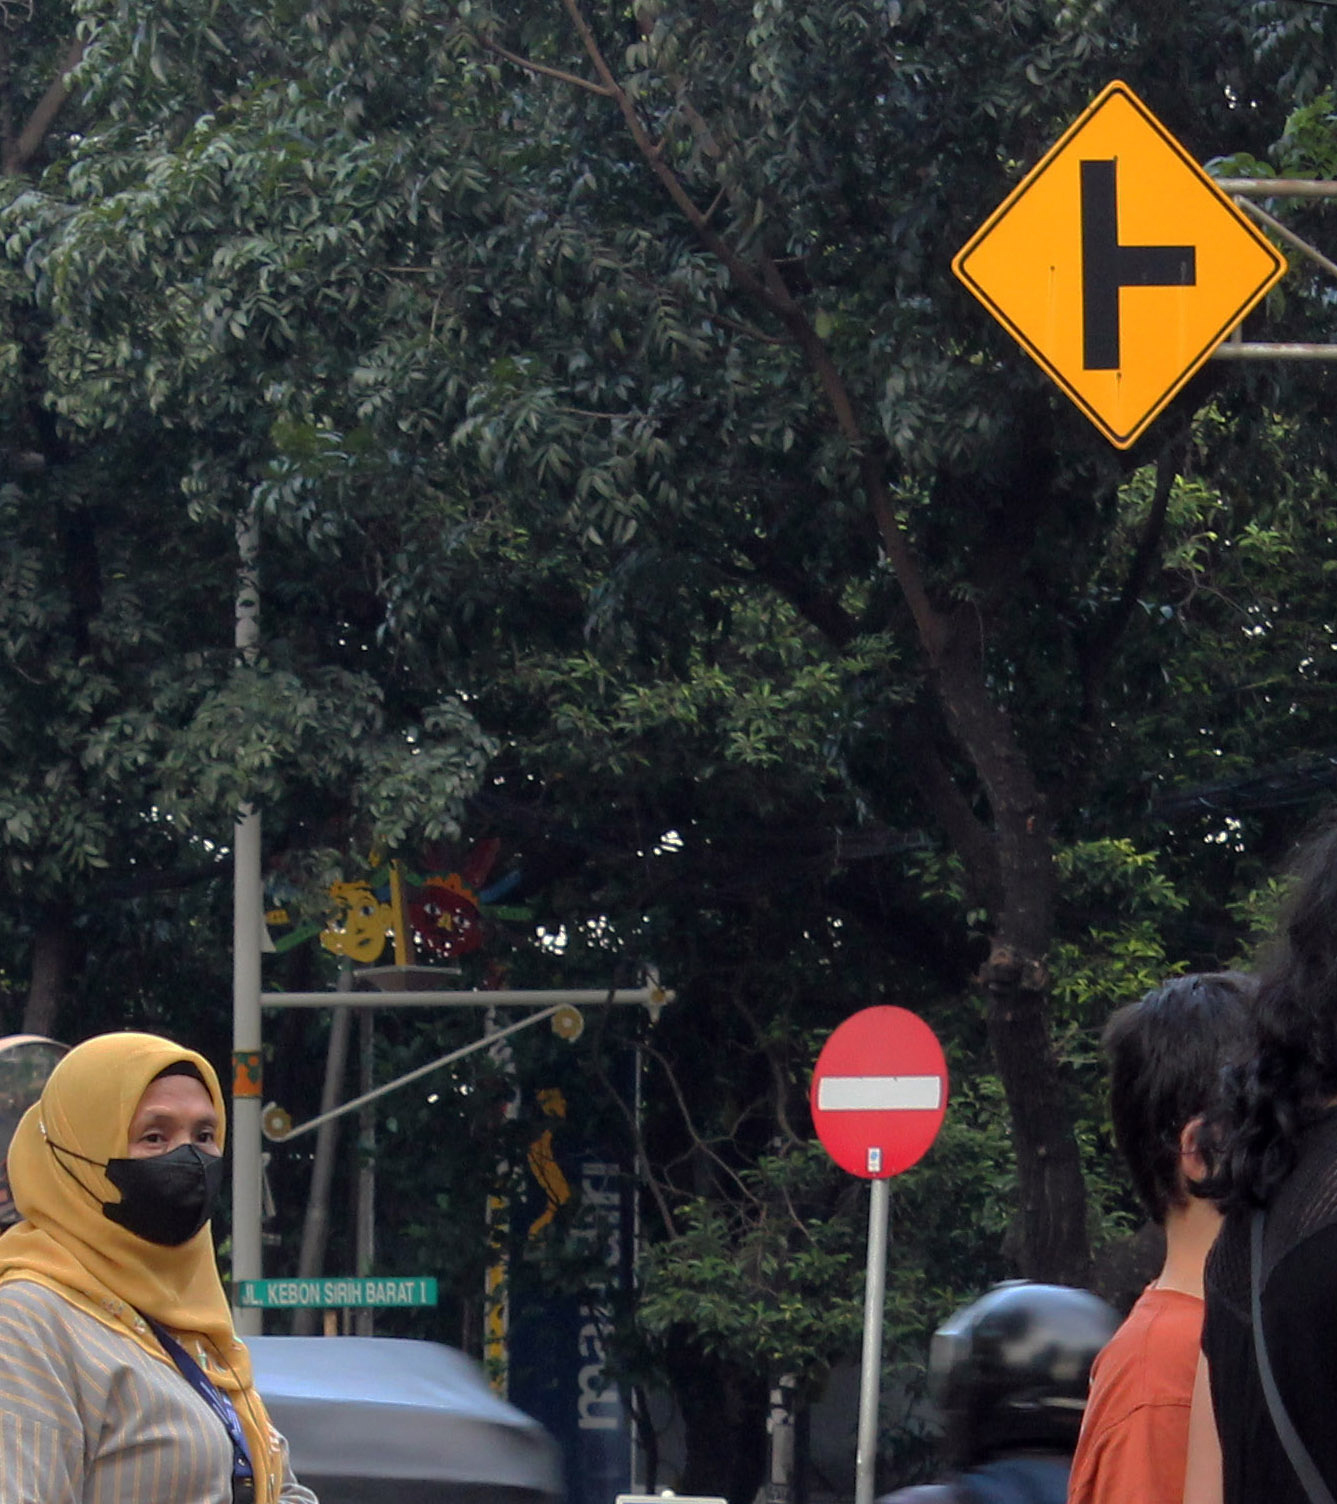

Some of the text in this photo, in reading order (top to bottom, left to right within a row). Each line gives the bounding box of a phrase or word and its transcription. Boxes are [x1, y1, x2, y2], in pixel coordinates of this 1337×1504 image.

[242, 1284, 263, 1305] JL.
[267, 1282, 320, 1305] KEBON
[324, 1282, 363, 1305] SIRIH
[366, 1281, 414, 1305] BARAT
